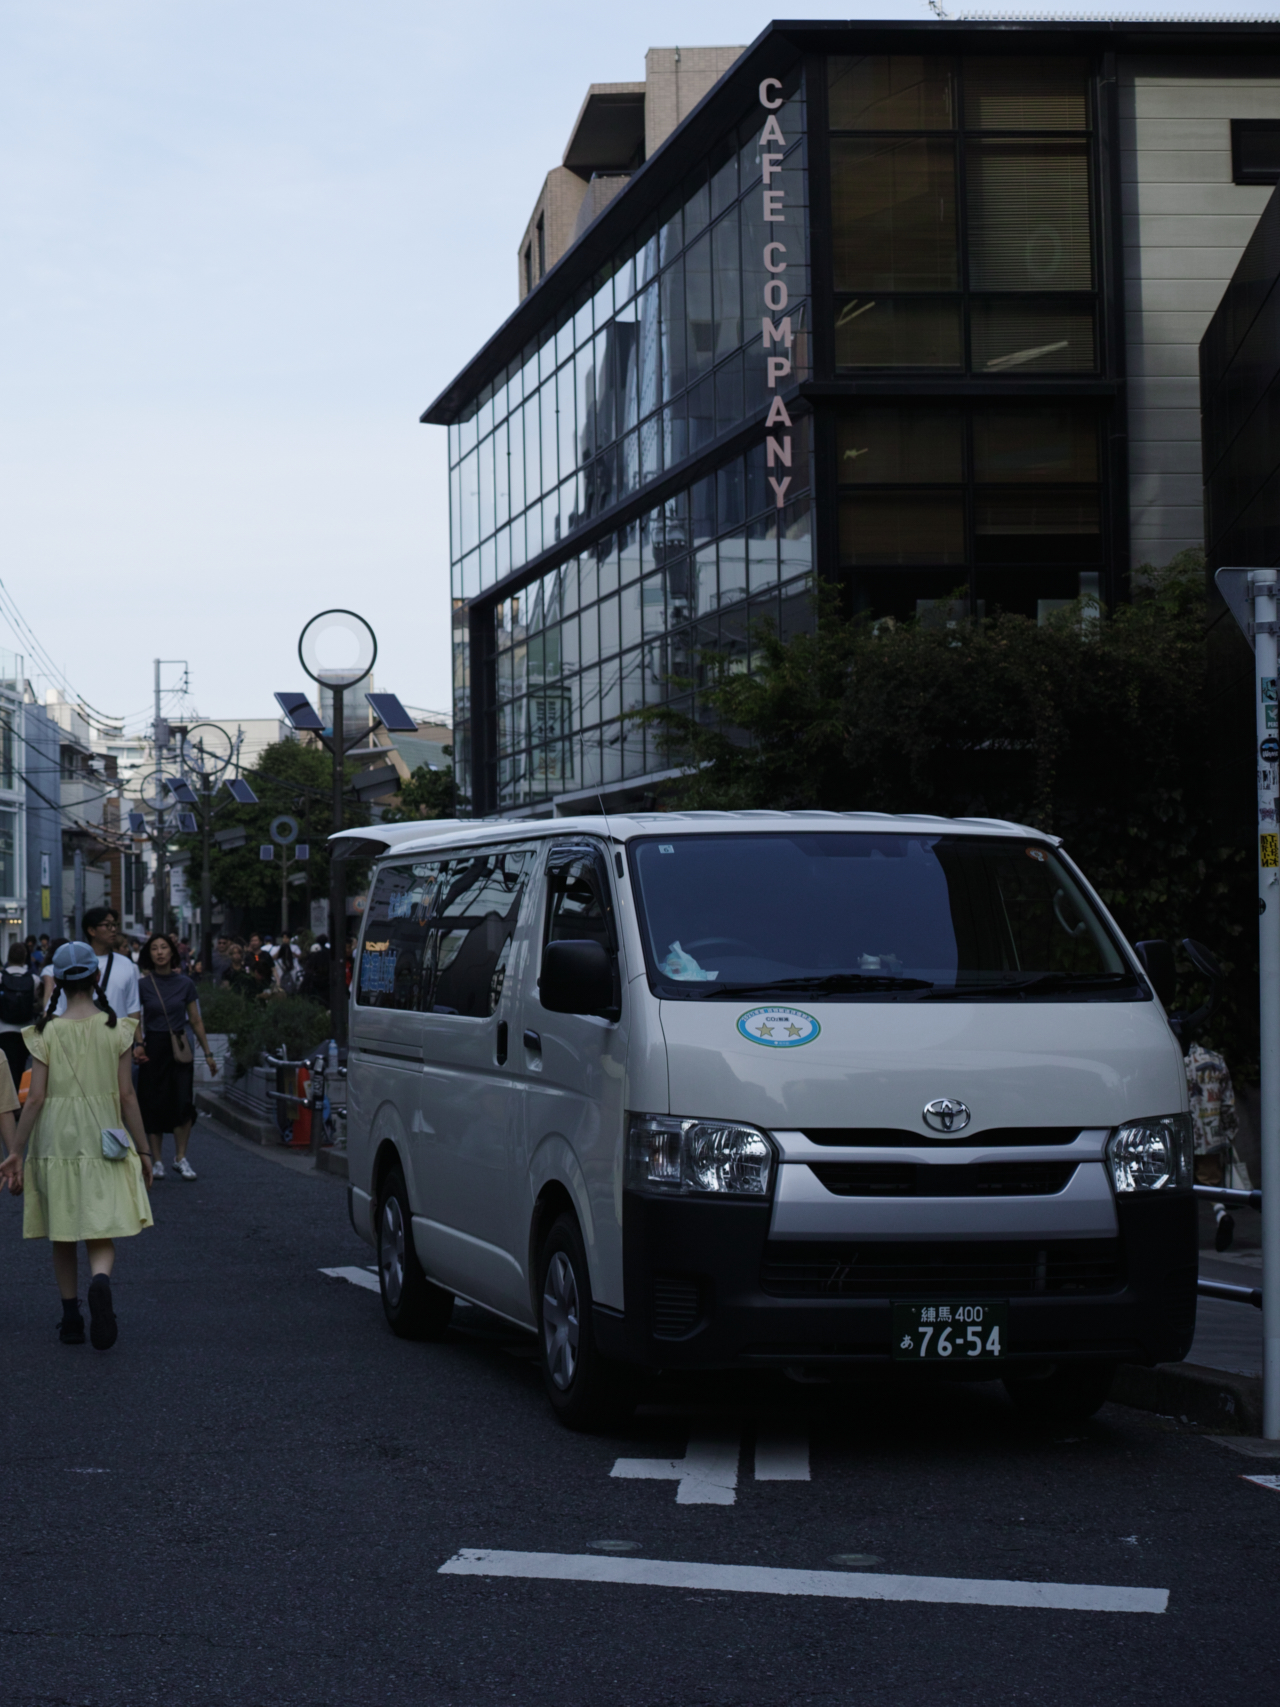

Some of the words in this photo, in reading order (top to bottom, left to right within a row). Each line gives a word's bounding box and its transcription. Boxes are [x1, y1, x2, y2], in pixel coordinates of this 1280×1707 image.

[758, 77, 786, 223] CAFE
[761, 241, 793, 509] COMPANY
[900, 1333, 914, 1351] あ
[918, 1325, 1003, 1358] 76-54
[921, 1306, 953, 1323] 練馬
[955, 1306, 984, 1323] 400
